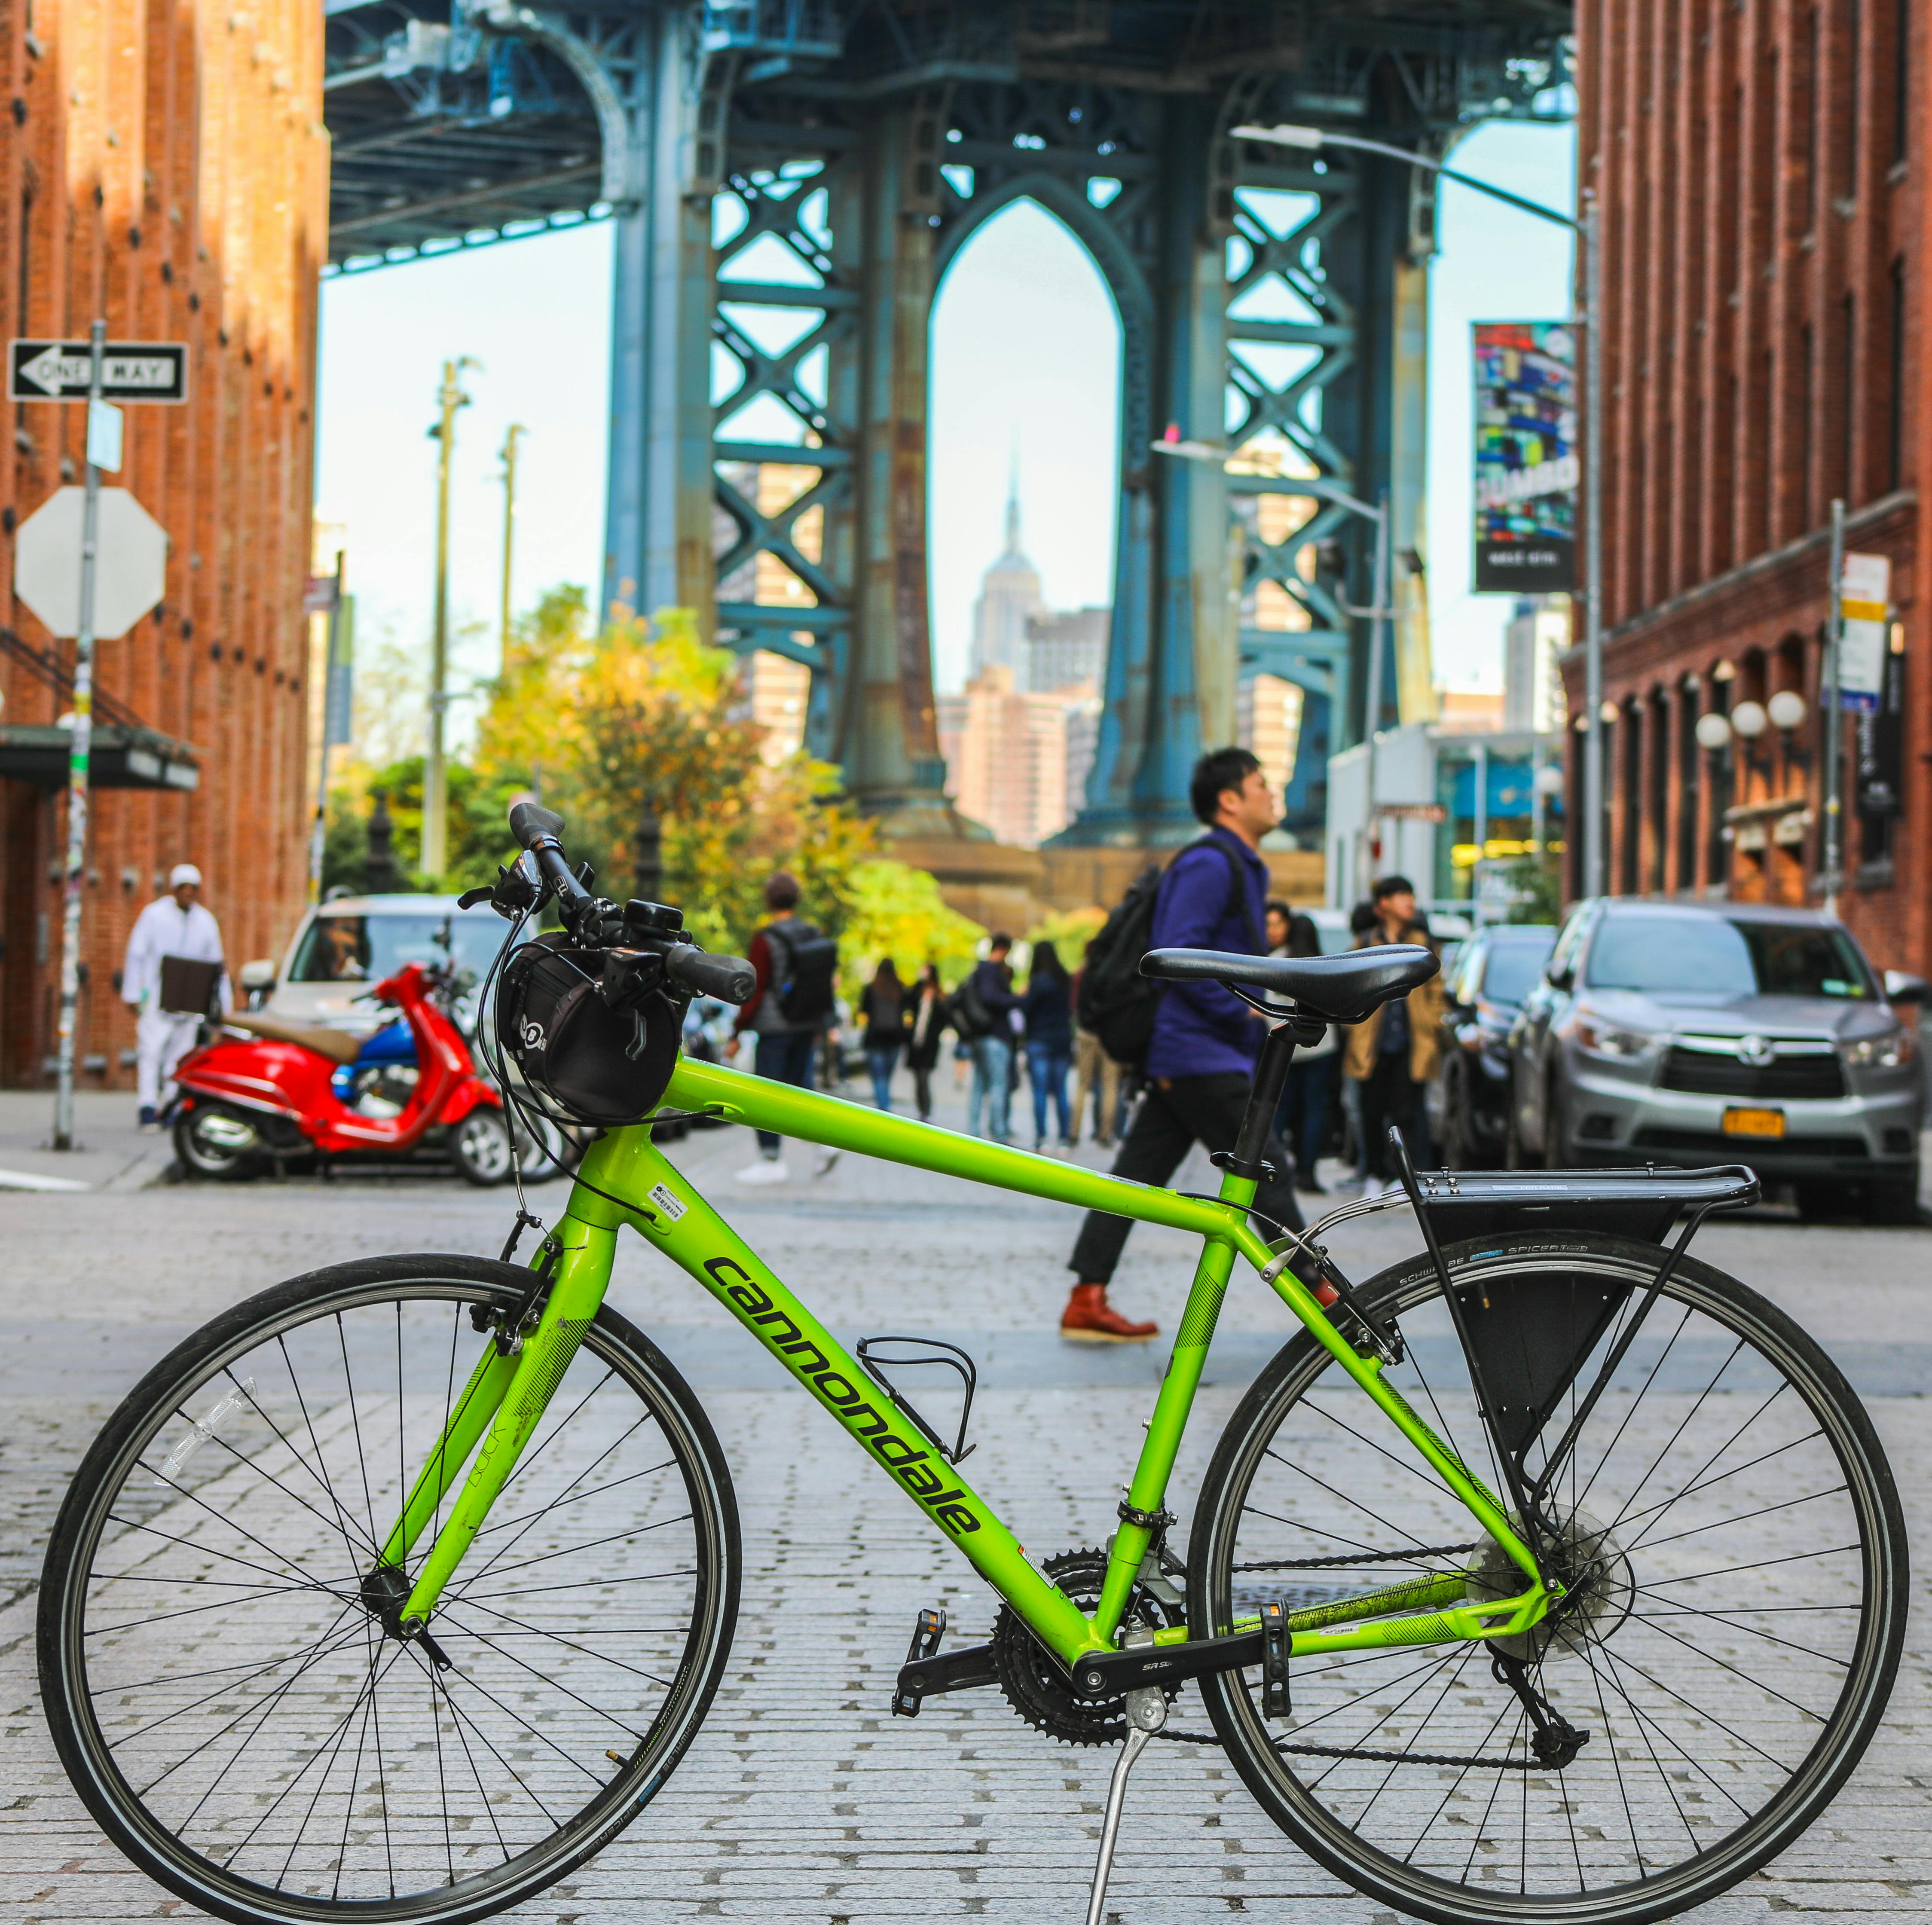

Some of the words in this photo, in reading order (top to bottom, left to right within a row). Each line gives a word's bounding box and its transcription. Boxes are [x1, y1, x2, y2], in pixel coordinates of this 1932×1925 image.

[39, 362, 83, 381] ONE
[113, 363, 162, 381] WAY
[1508, 1245, 1559, 1255] SPICER
[663, 1712, 698, 1772] SCHWALBE
[600, 1803, 637, 1841] SPICER
